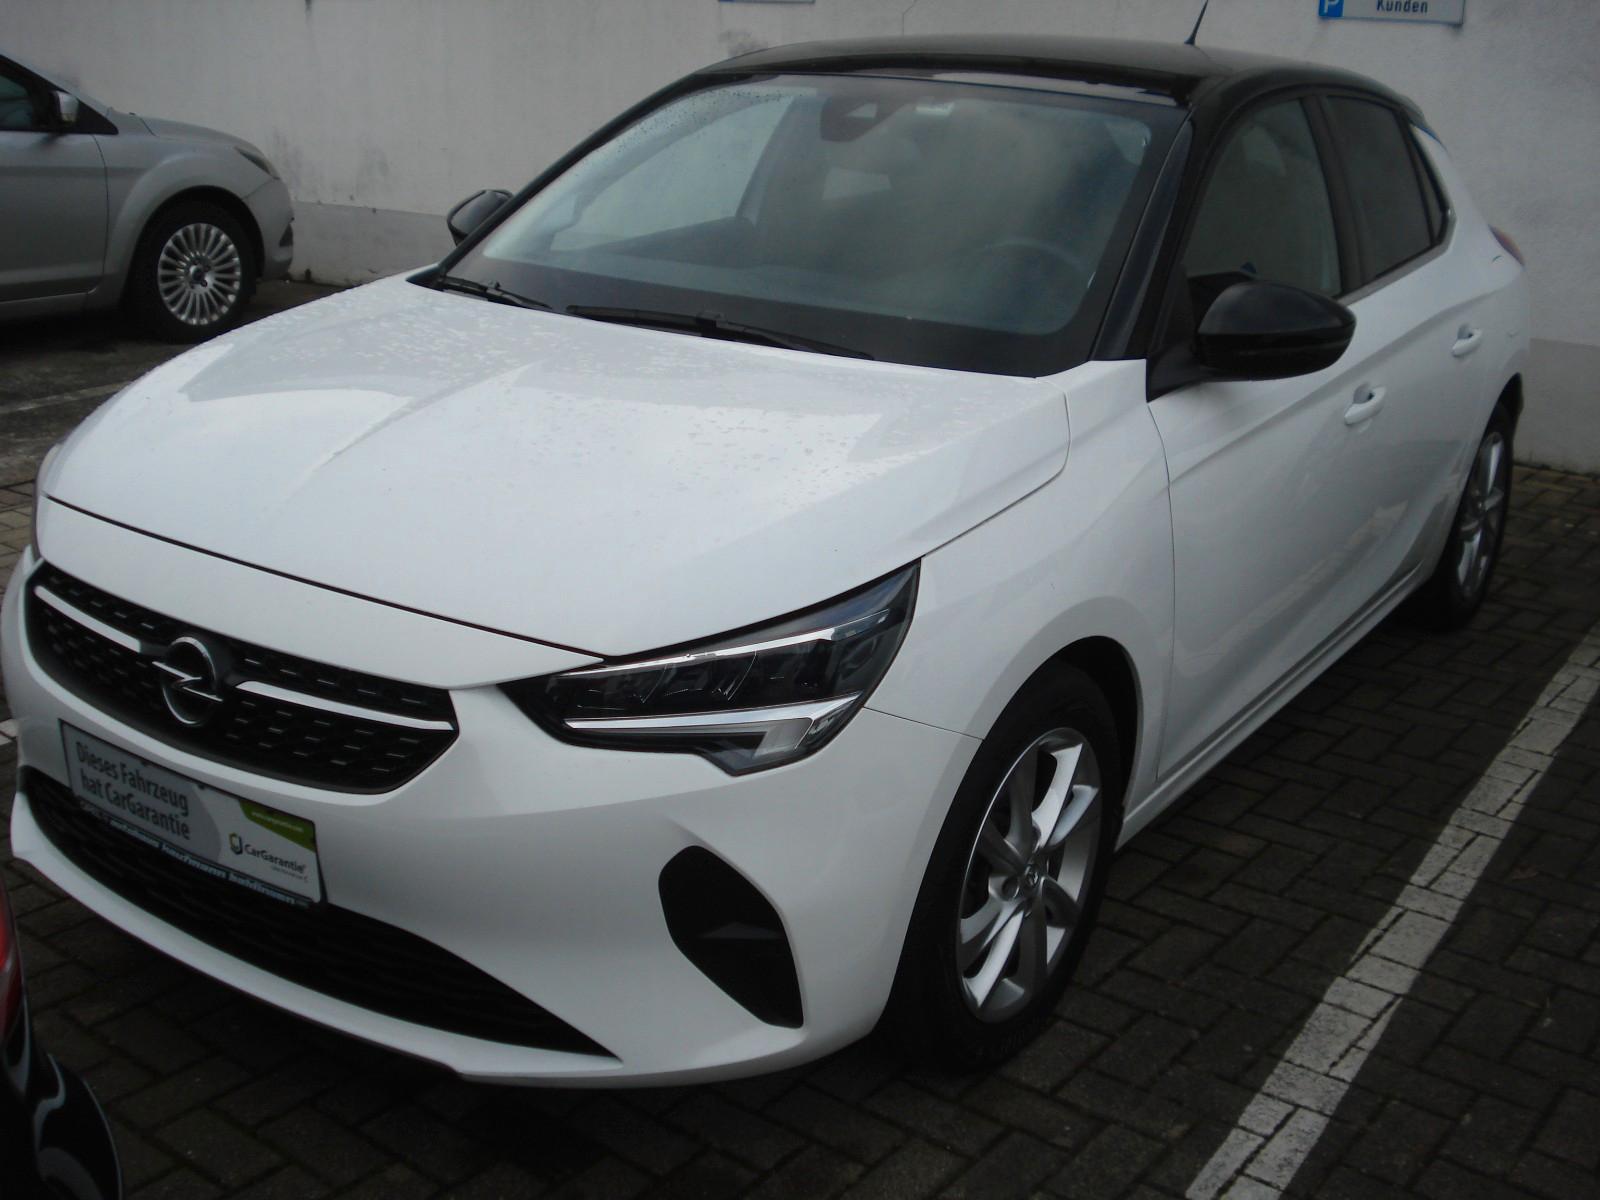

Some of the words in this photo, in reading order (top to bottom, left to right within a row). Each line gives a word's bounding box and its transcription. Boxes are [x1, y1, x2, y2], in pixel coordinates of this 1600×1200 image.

[1376, 0, 1428, 13] Kunden
[76, 741, 118, 779] Dieses
[120, 763, 189, 817] Fahrzeug
[81, 767, 103, 798] hat
[105, 782, 190, 840] CarGarantie
